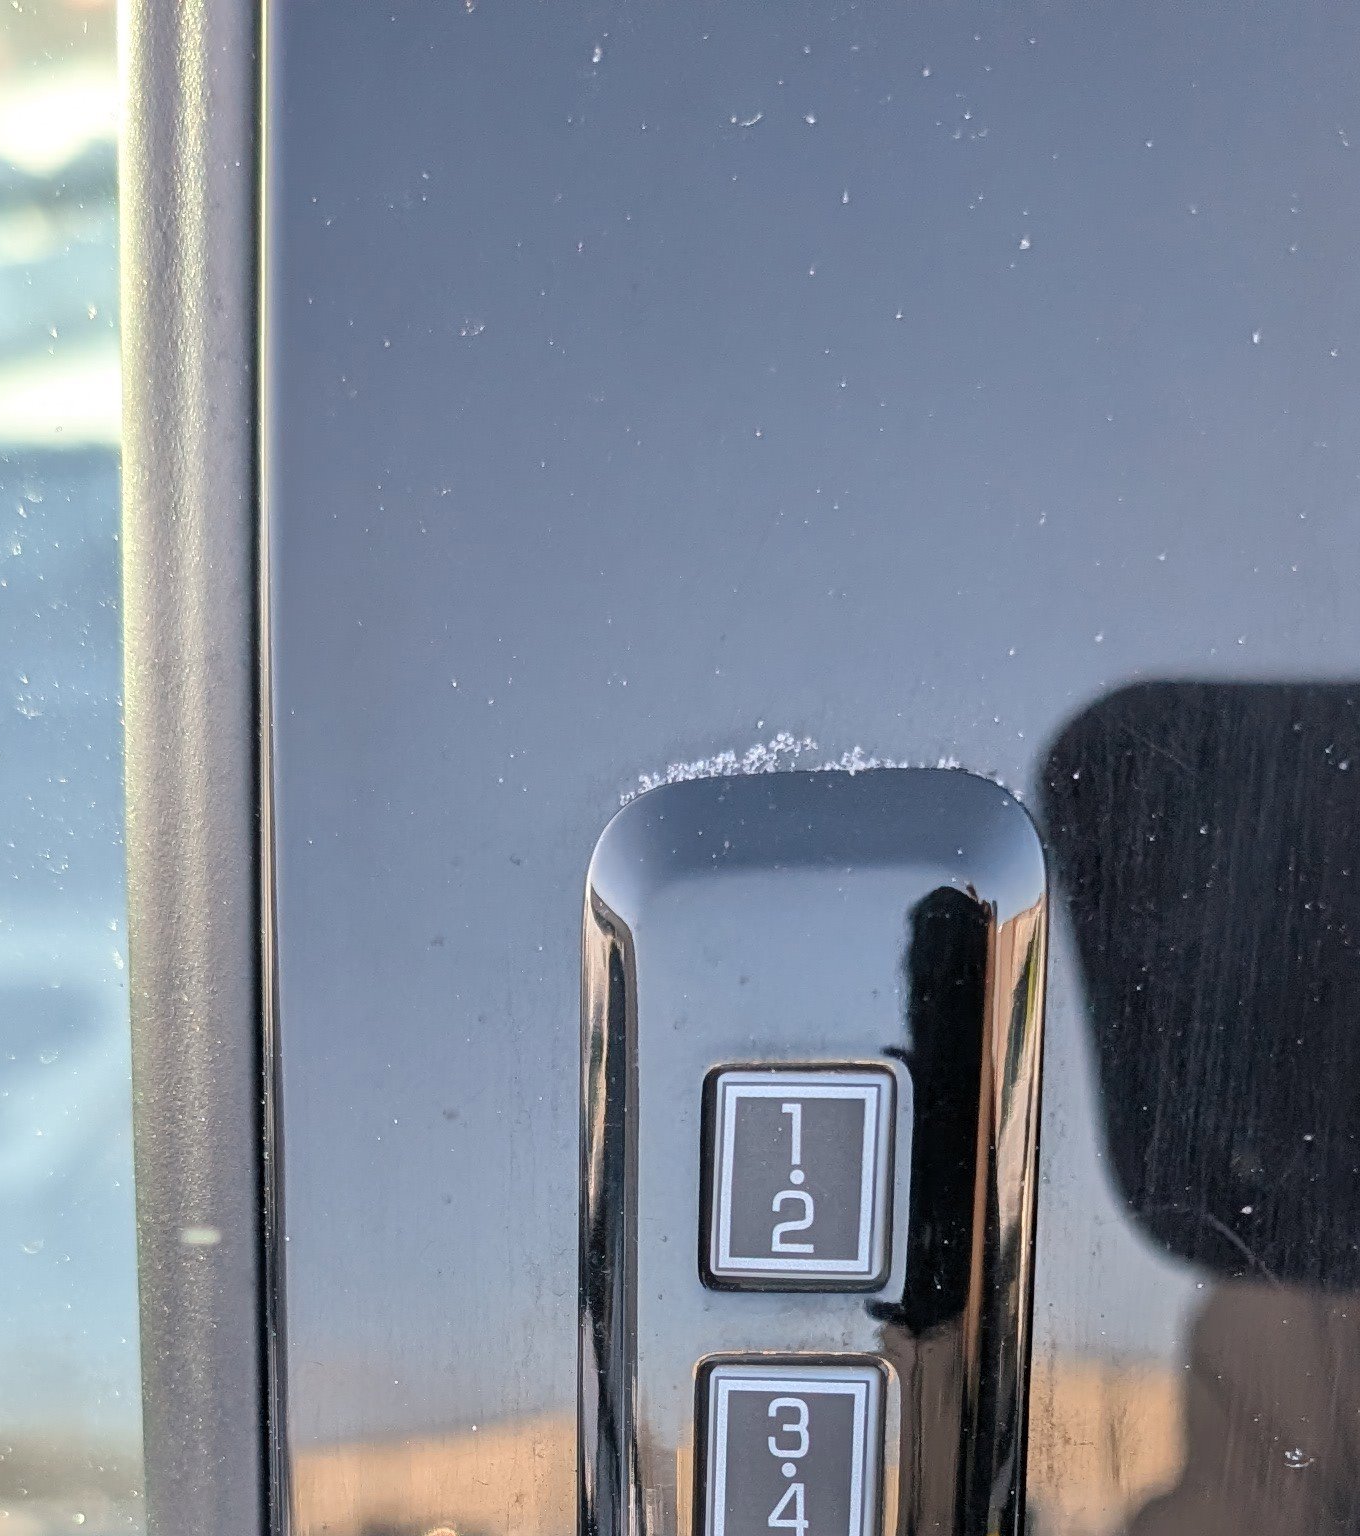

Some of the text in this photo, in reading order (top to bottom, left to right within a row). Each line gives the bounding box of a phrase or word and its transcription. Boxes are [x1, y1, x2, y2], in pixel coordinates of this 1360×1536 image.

[781, 1103, 801, 1165] 1
[771, 1190, 815, 1254] 2
[767, 1397, 810, 1459] 3
